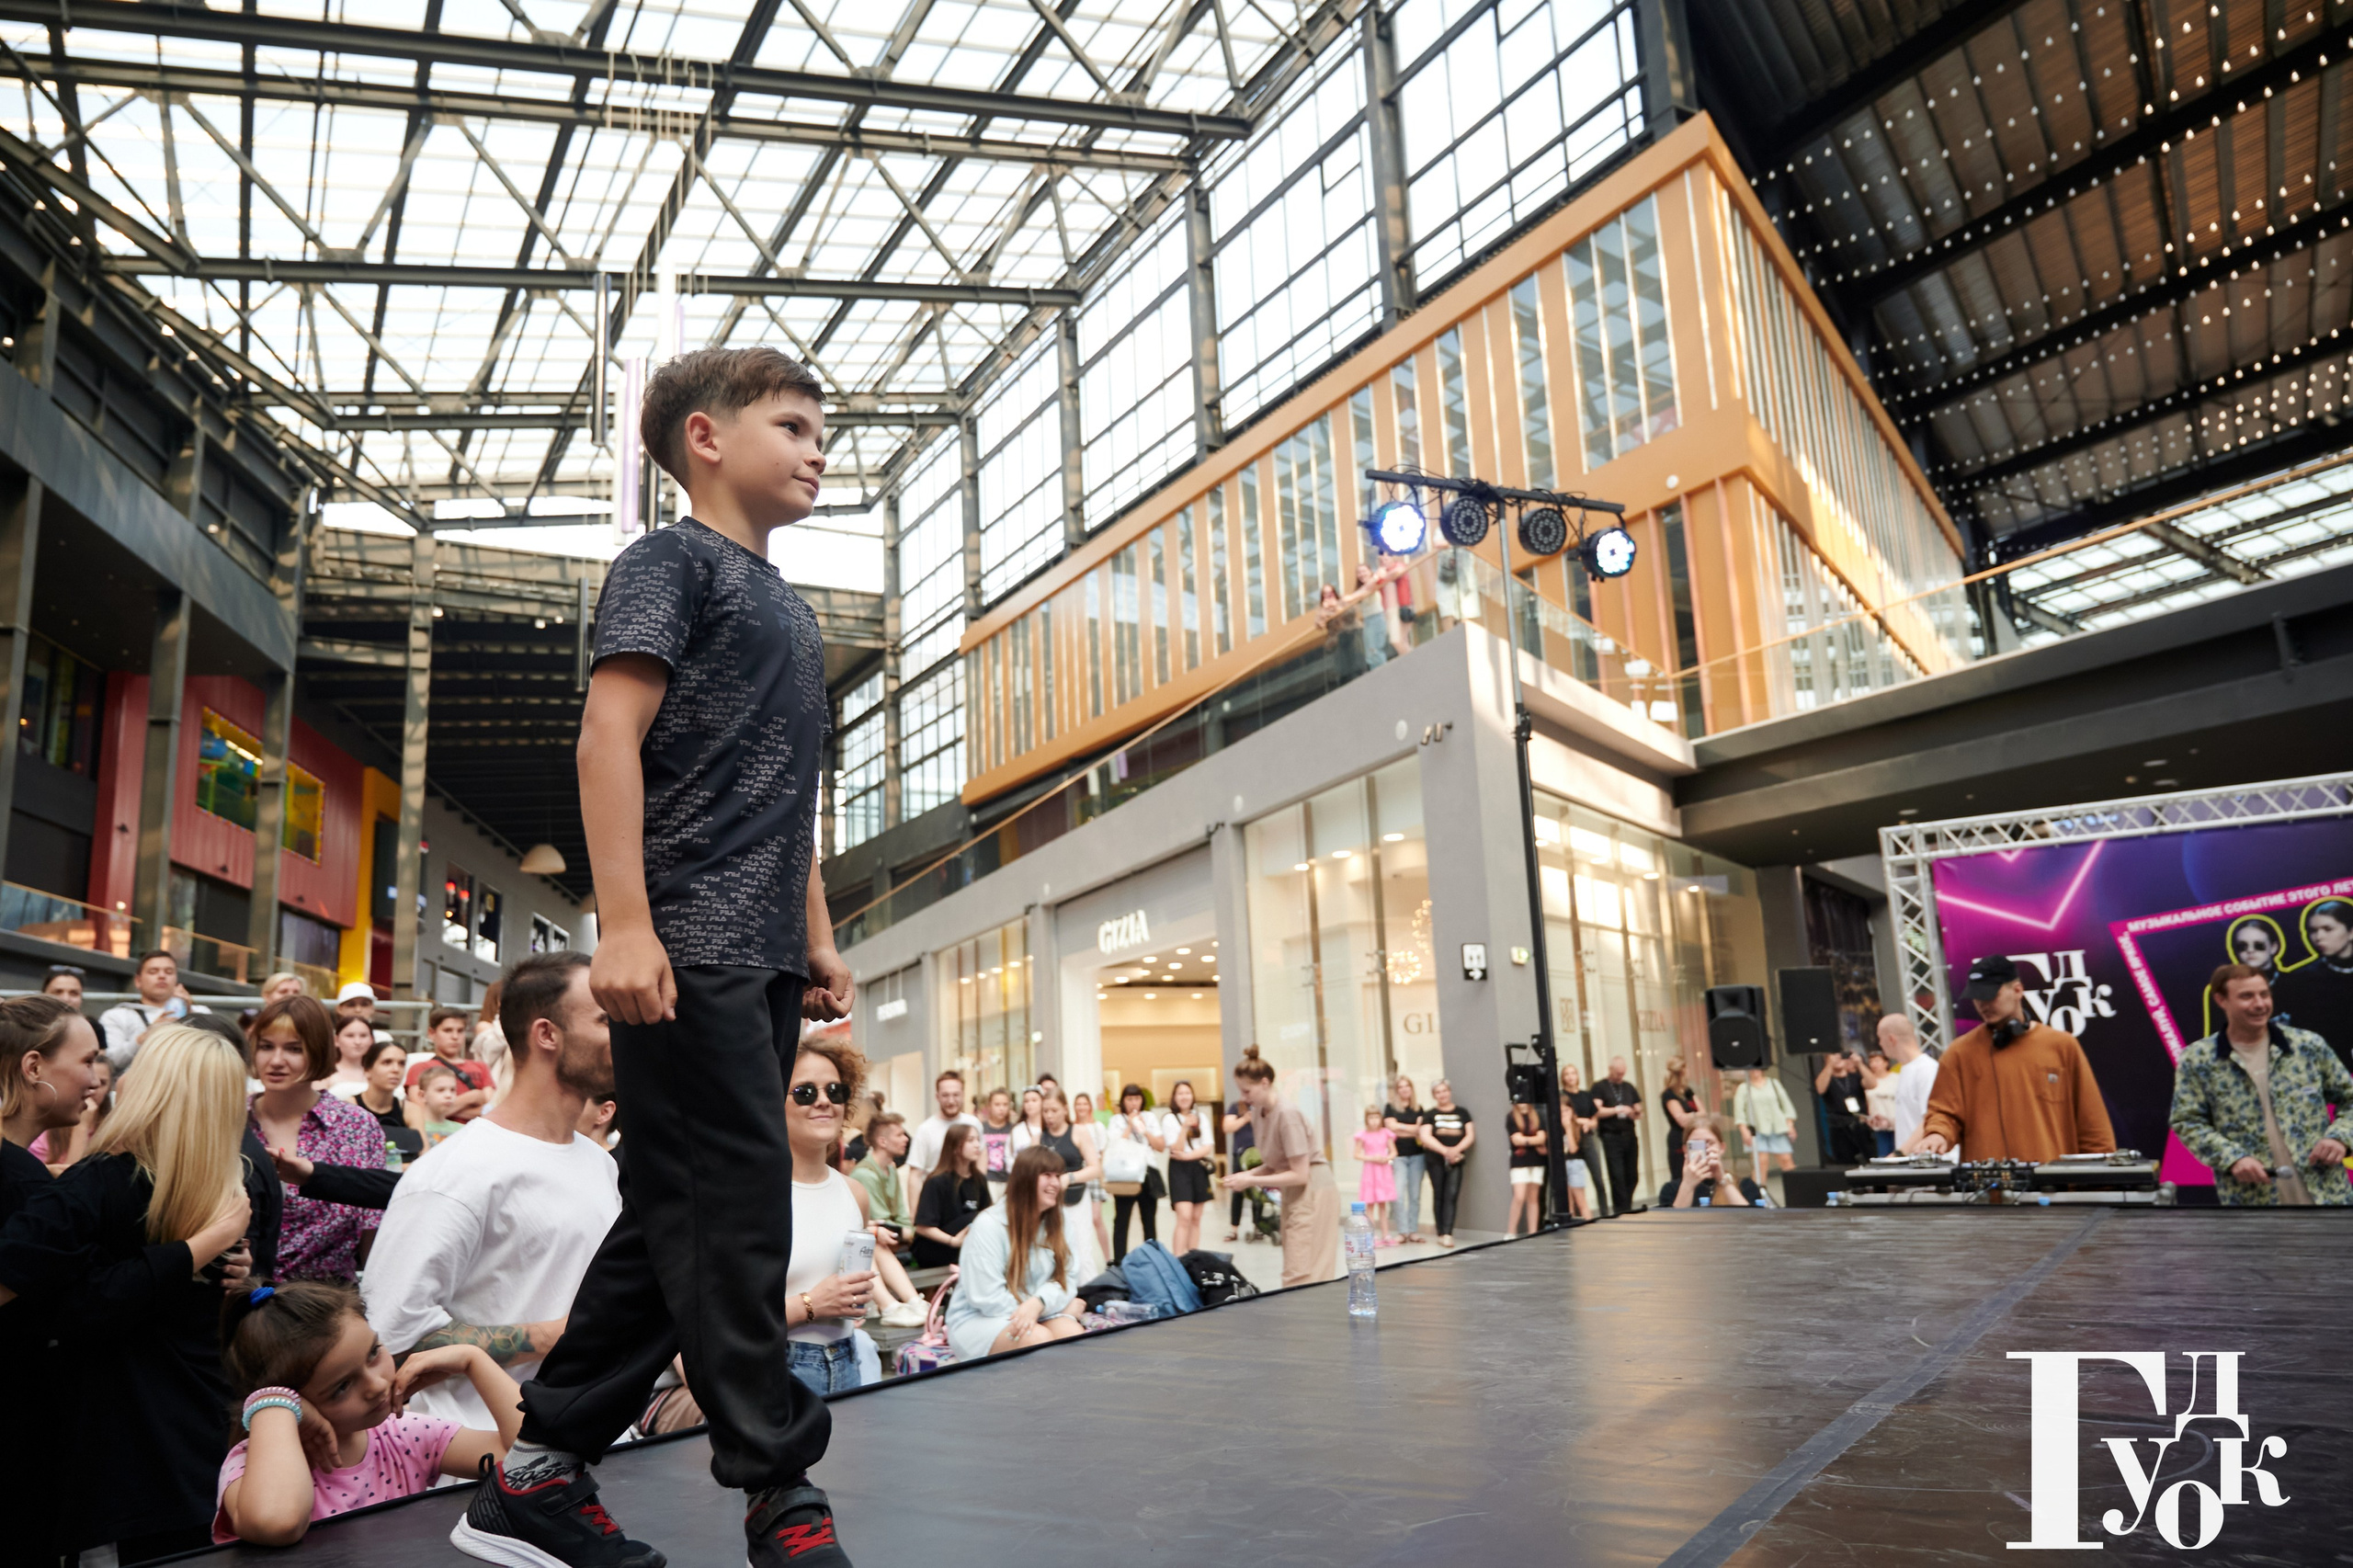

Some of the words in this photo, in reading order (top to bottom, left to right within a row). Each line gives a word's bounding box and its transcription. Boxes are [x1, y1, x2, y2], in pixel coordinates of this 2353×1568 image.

[2127, 904, 2222, 932] МУЗЫКАЛЬНОЕ
[2224, 893, 2286, 915] СОБЫТИЕ
[2288, 885, 2331, 903] ЭТОГО
[1098, 909, 1150, 955] GIZIA
[2133, 967, 2161, 1007] САМОЕ
